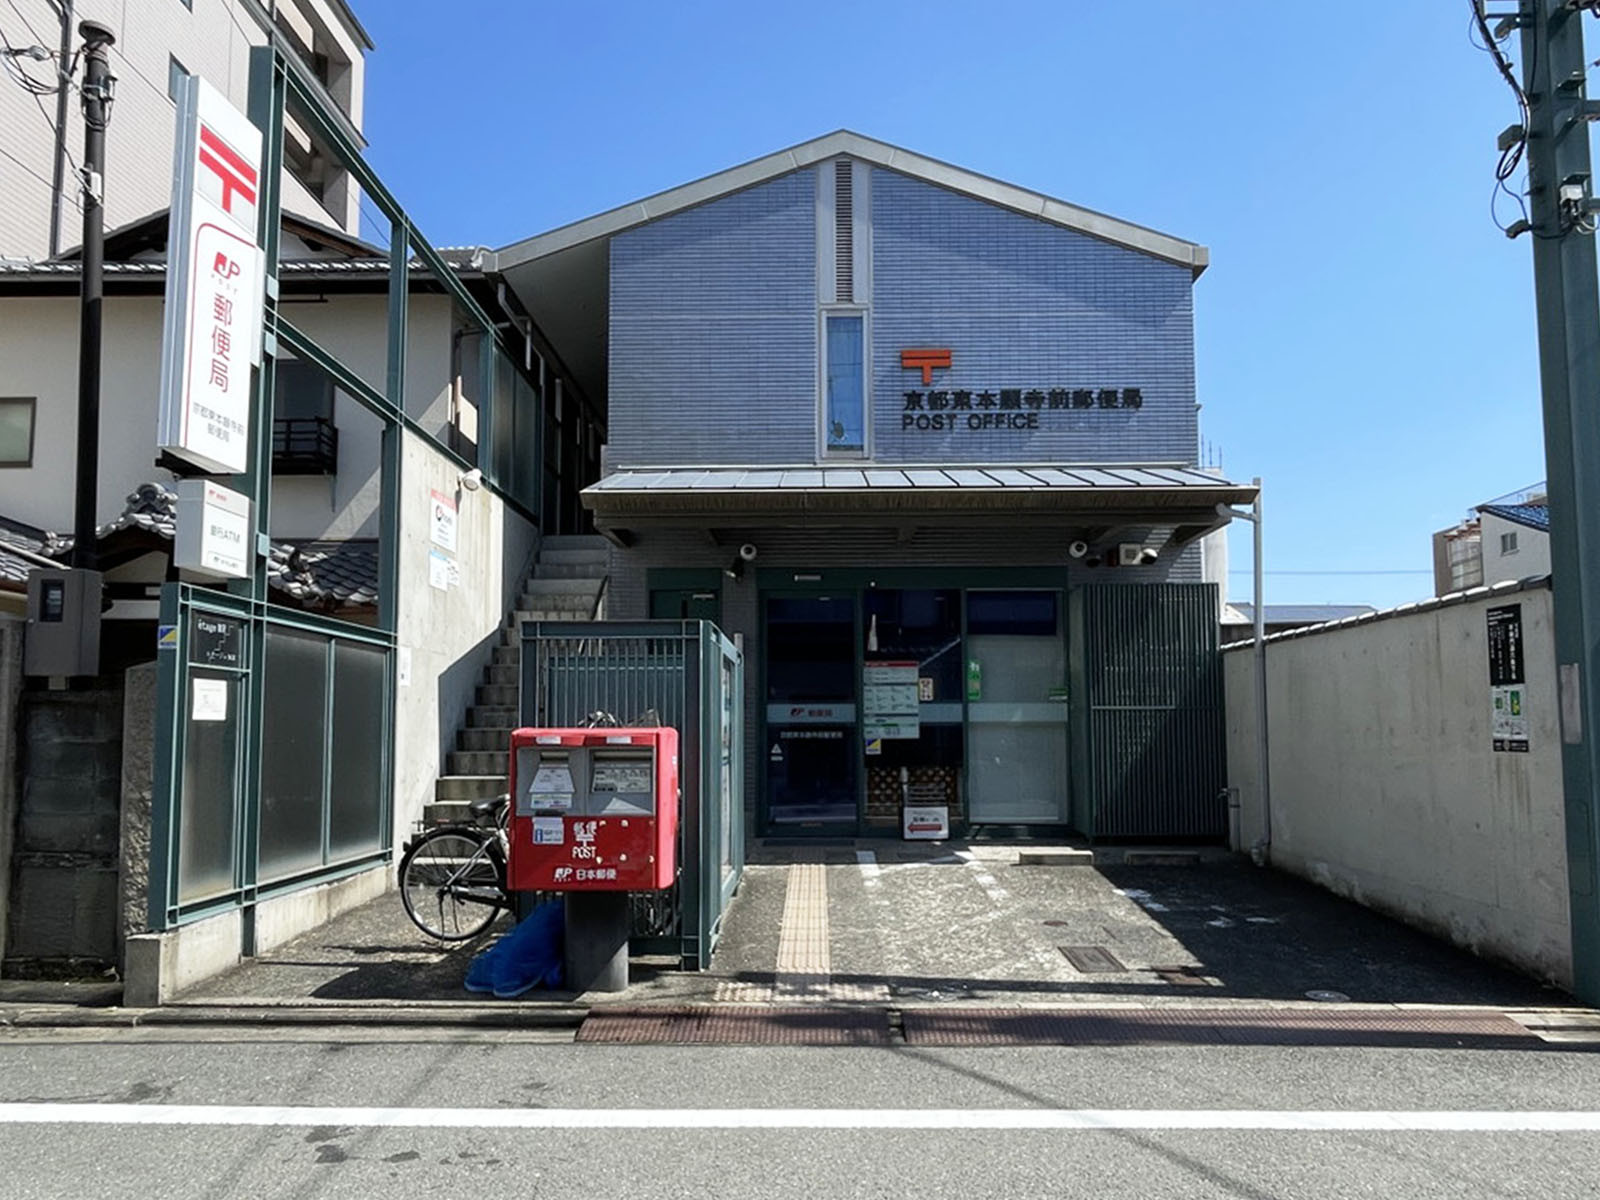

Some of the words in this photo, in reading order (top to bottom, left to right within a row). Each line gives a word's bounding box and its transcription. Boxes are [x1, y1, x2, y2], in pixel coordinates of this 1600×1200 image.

[209, 292, 233, 393] 郵便局
[902, 413, 957, 431] POST
[968, 413, 1039, 430] OFFICE
[572, 846, 597, 859] POST
[576, 868, 617, 881] 日本郵便
